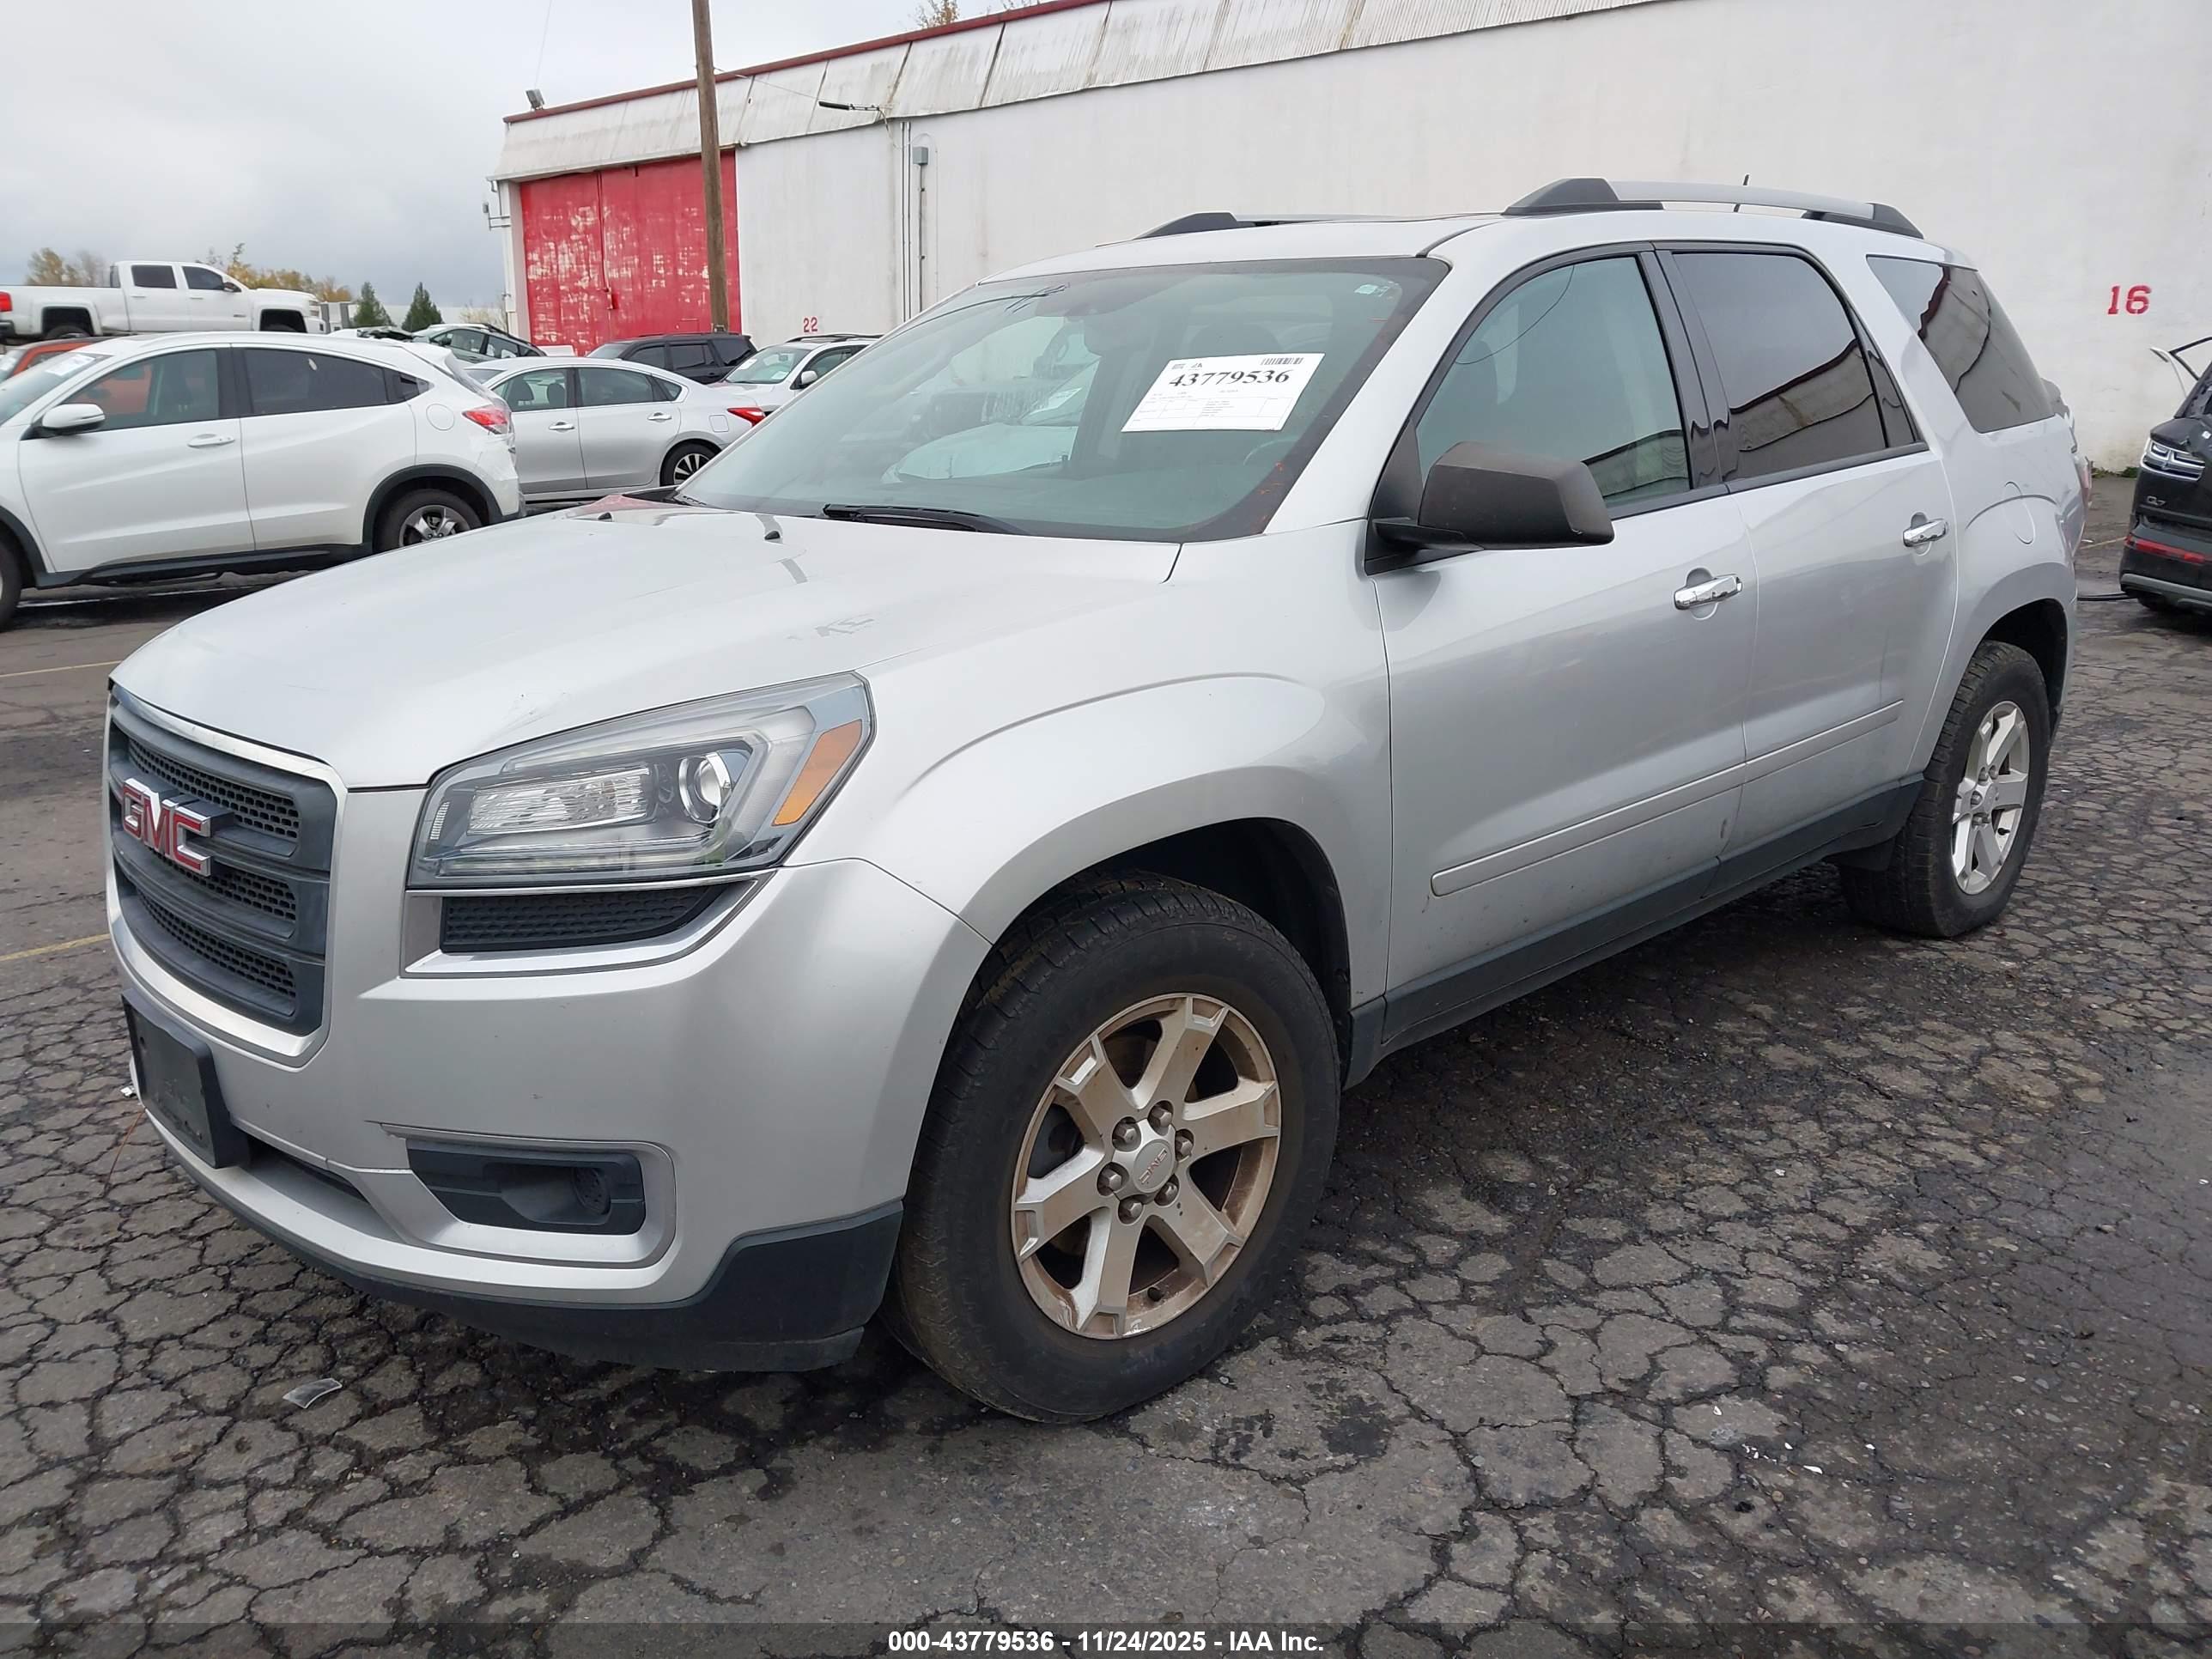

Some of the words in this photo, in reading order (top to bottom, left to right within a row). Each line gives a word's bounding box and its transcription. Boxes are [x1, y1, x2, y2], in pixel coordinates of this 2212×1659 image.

[2108, 285, 2152, 315] 16
[803, 317, 817, 332] 22
[1169, 369, 1294, 386] 43779536
[123, 778, 211, 877] GMC
[1139, 1147, 1168, 1184] GMC
